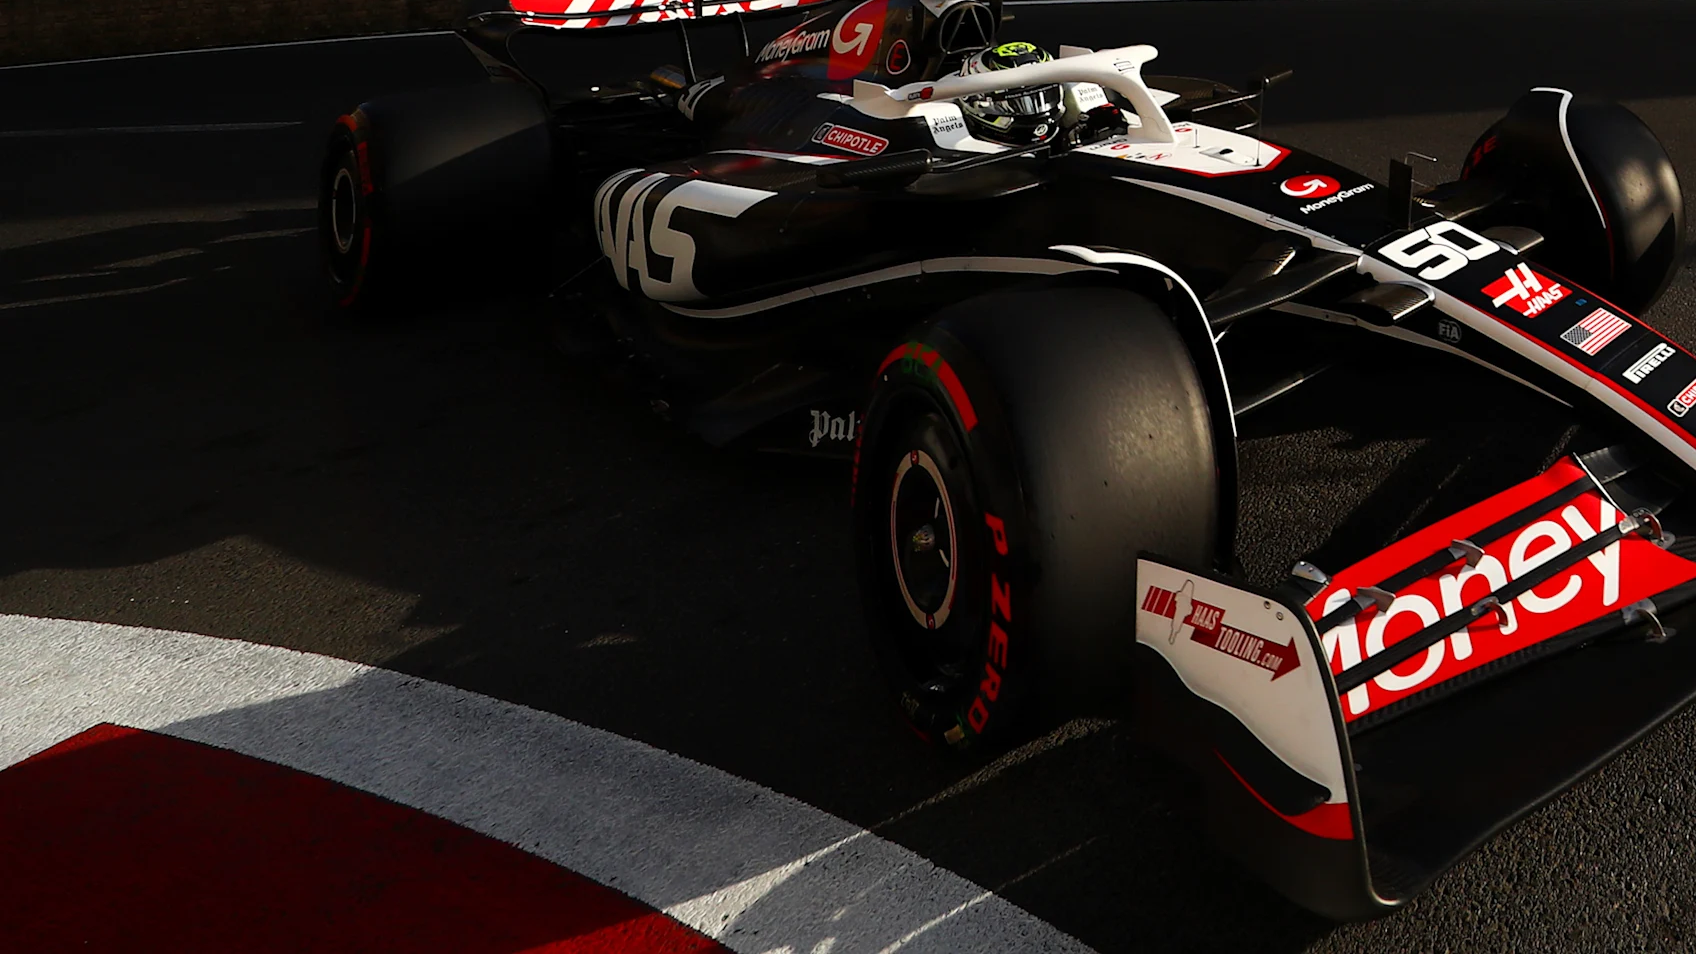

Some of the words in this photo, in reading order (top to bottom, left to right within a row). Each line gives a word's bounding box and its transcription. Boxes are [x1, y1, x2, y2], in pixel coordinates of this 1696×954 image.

[755, 28, 831, 64] MoneyGram
[932, 121, 964, 134] Angels
[933, 116, 958, 127] Palm
[827, 128, 883, 154] CHIPOTLE
[1299, 182, 1375, 215] MoneyGram
[1377, 220, 1501, 281] 50
[1522, 282, 1564, 317] HAAS
[1622, 342, 1677, 385] PIRELLI
[808, 410, 862, 448] Pal
[984, 511, 1009, 557] P
[1190, 604, 1221, 631] HAAS
[967, 571, 1012, 735] ZERO
